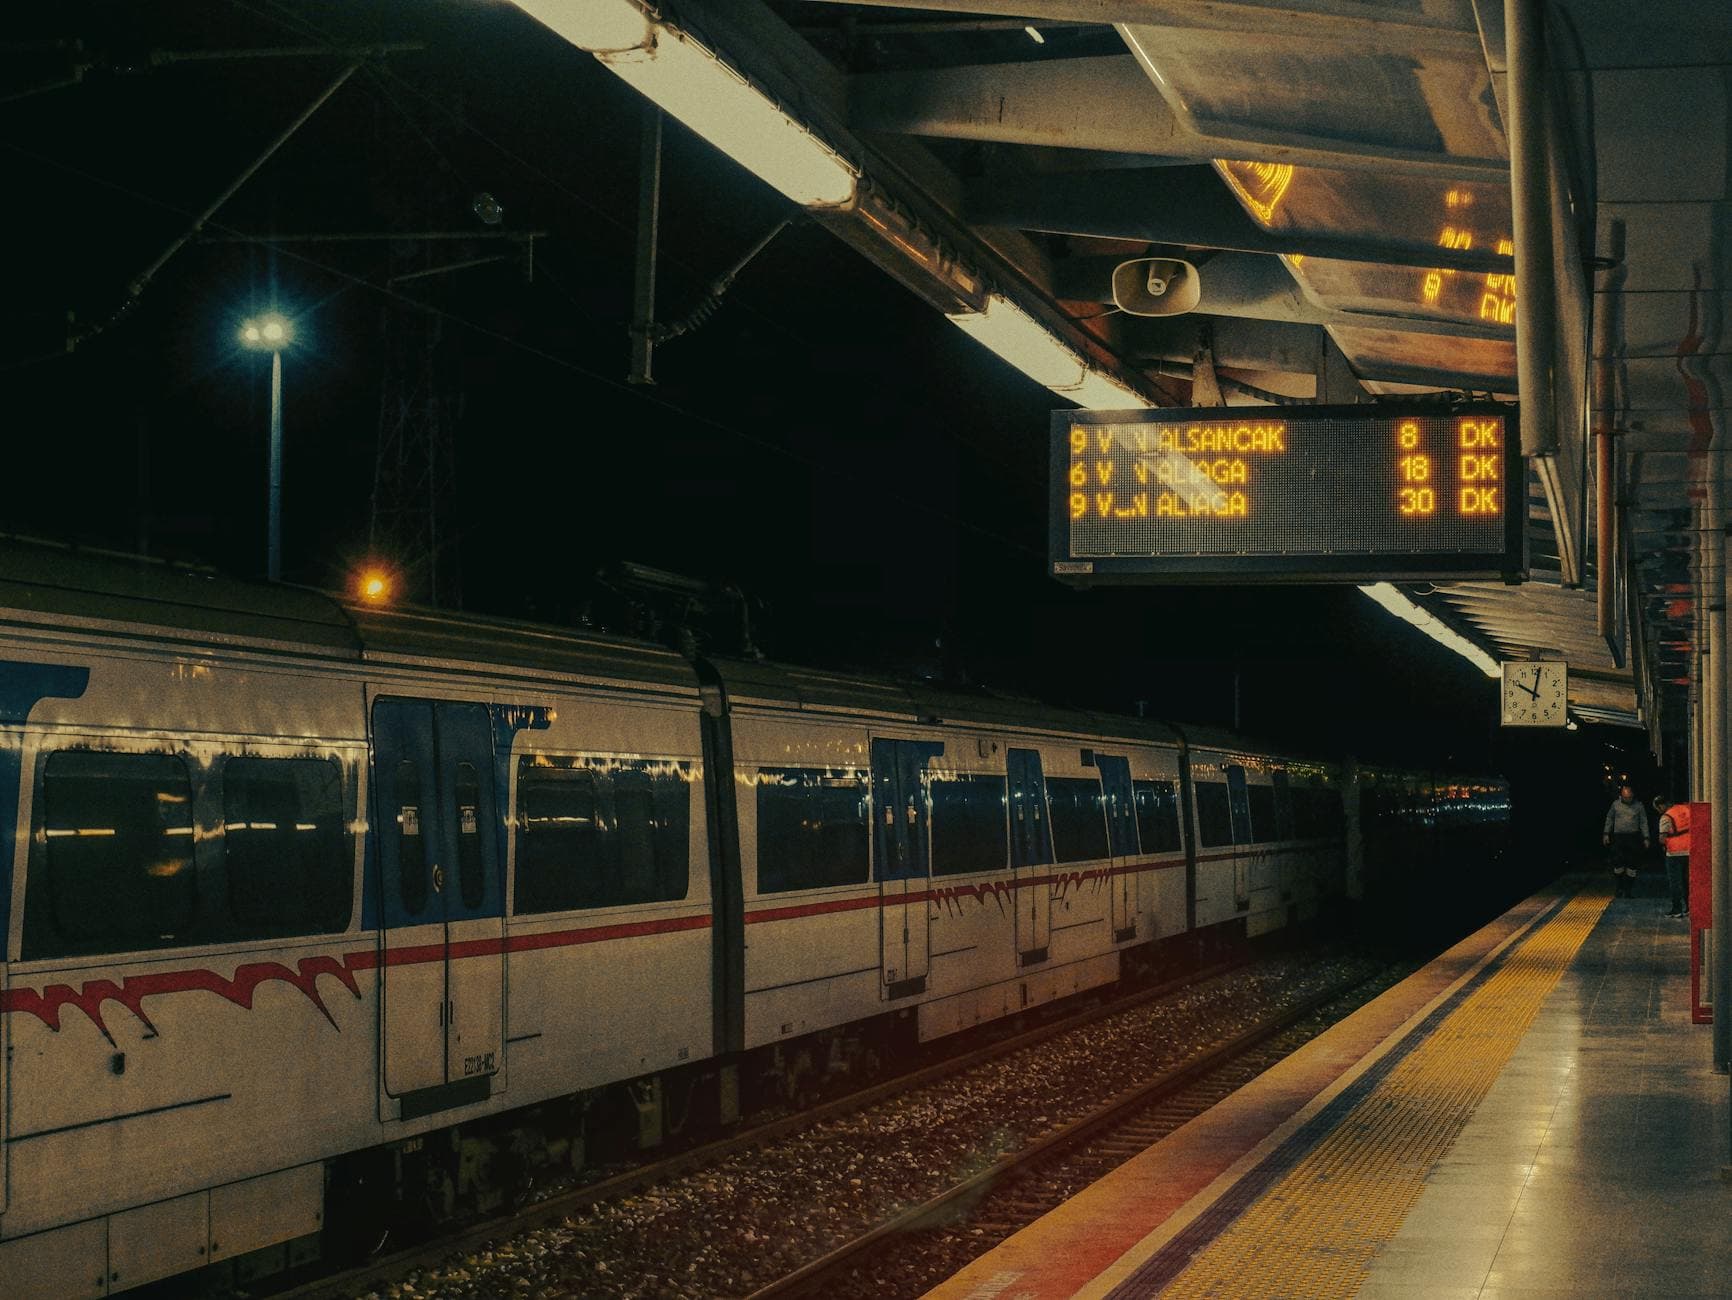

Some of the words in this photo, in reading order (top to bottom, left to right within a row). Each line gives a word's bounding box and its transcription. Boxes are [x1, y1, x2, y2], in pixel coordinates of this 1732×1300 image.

[1071, 429, 1087, 454] 9
[1159, 427, 1285, 451] ALSANCAK
[1401, 423, 1417, 448] 8
[1462, 422, 1497, 447] DK
[1071, 461, 1087, 486] 6
[1401, 456, 1428, 480] 18
[1462, 455, 1497, 480] DK
[1071, 492, 1087, 518] 9
[1158, 492, 1246, 516] ALIAGA
[1400, 488, 1434, 513] 30
[1462, 488, 1497, 512] DK
[1521, 709, 1527, 717] 7
[1543, 709, 1549, 717] 5
